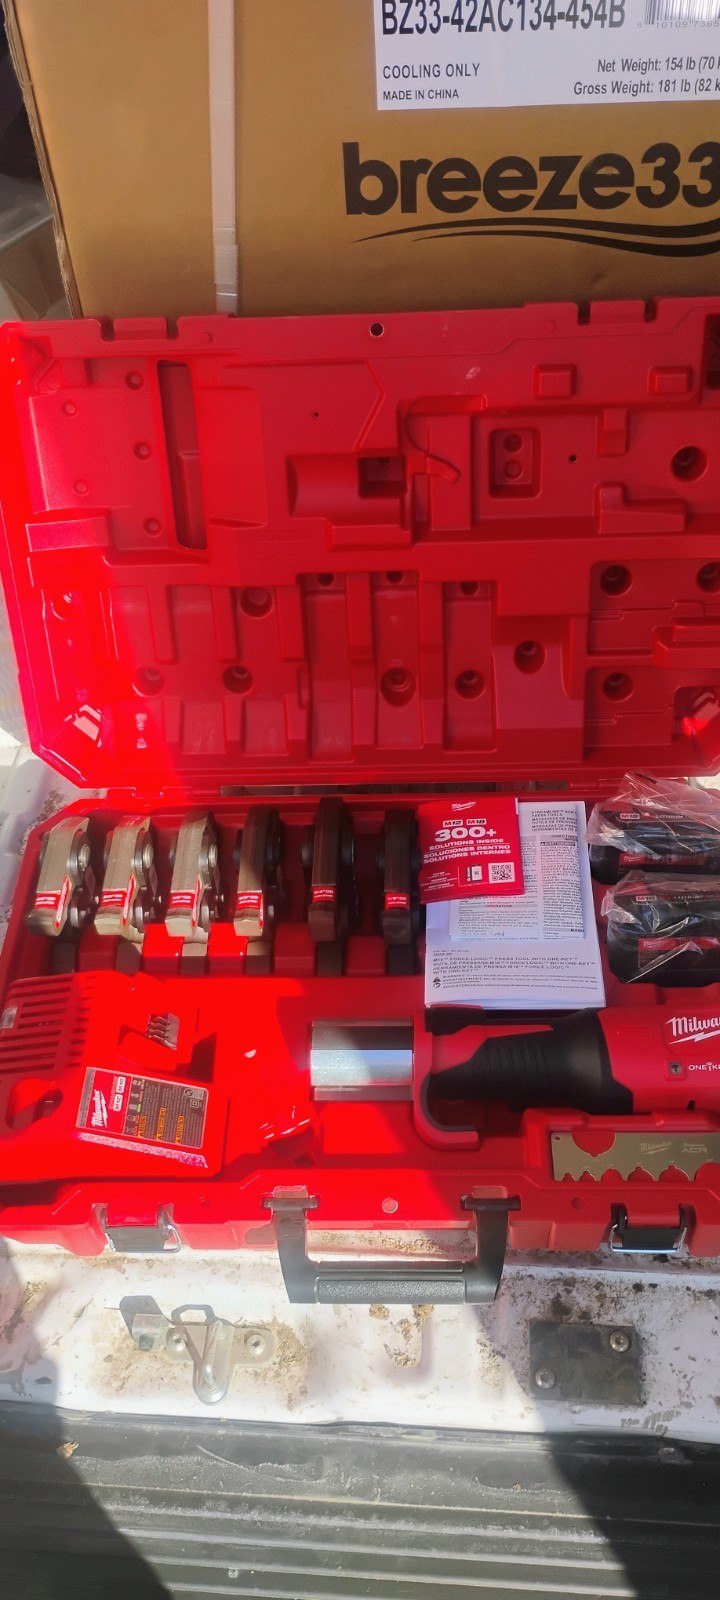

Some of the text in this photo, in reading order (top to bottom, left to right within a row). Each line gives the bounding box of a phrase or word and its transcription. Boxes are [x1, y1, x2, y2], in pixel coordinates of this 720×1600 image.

[382, 0, 626, 35] BZ33-42AC134-454B
[383, 63, 480, 79] COOLING ONLY
[597, 59, 616, 72] Net
[621, 58, 661, 75] Weight:
[665, 57, 683, 70] 154
[685, 57, 696, 70] lb
[698, 56, 715, 73] (70
[383, 88, 459, 100] MADE IN CHINA
[573, 81, 607, 95] Gross
[611, 80, 654, 97] Weight:
[658, 79, 677, 93] 181
[680, 79, 691, 92] lb
[694, 78, 712, 95] (82
[342, 141, 720, 215] breeze33
[435, 826, 497, 842] 300+
[423, 846, 475, 859] SOLUCIONES
[429, 839, 474, 851] SOLUTIONS
[423, 852, 469, 864] SOLUTIONS
[665, 1016, 720, 1037] Milwa
